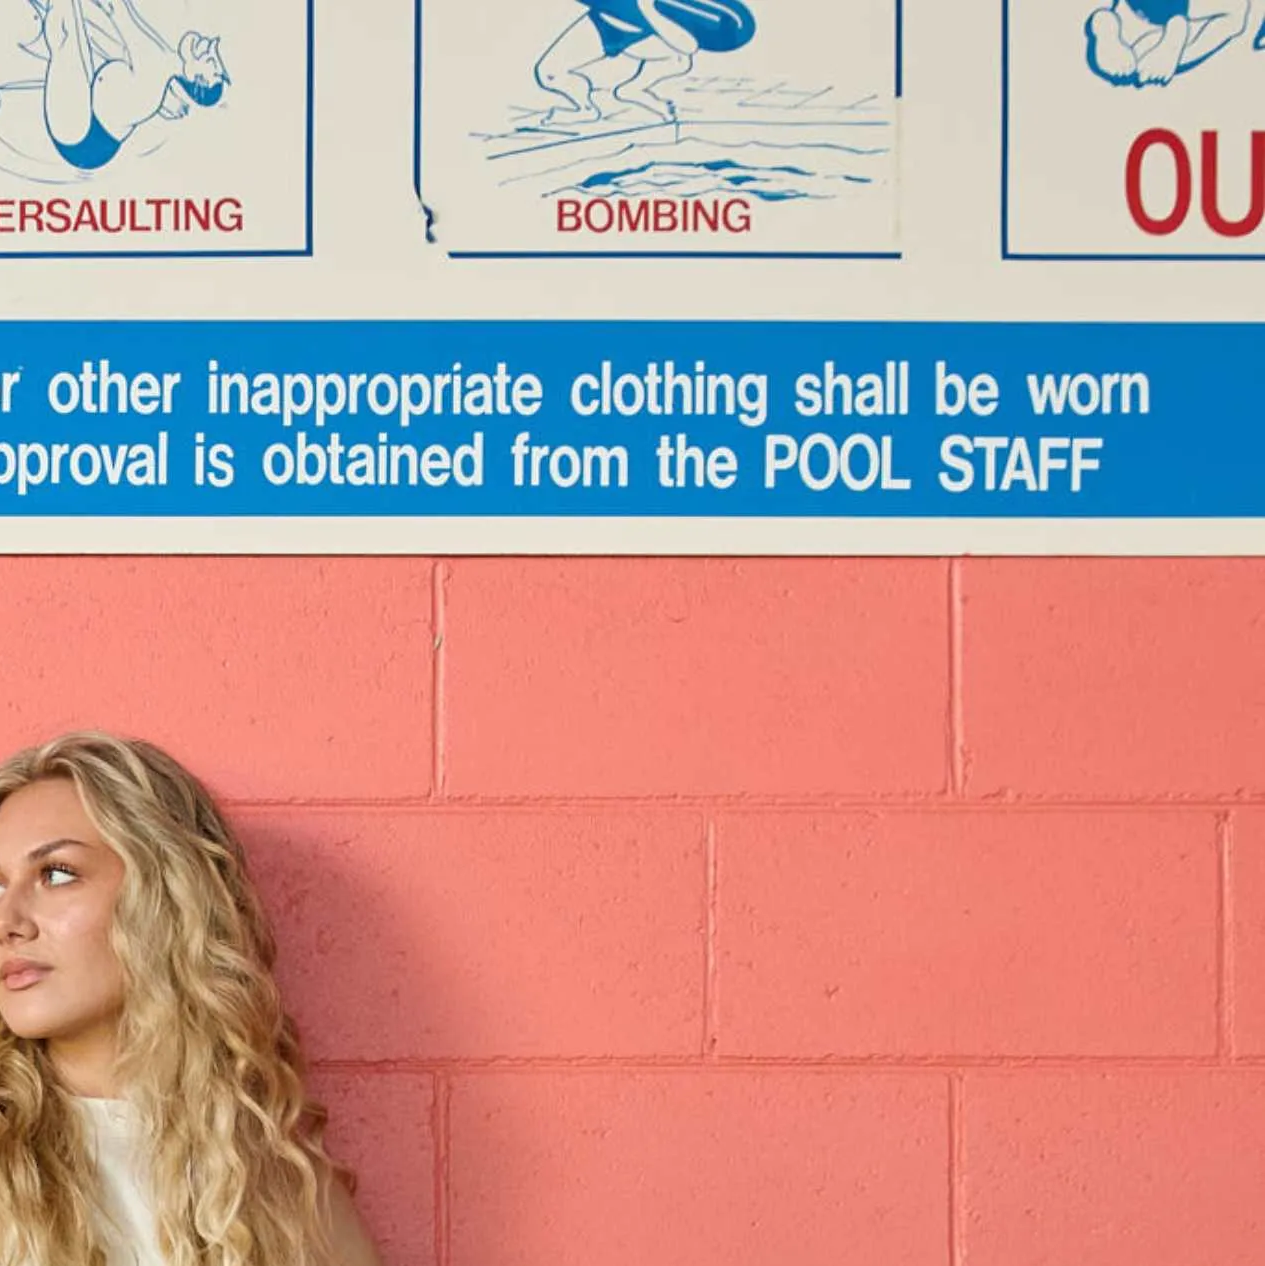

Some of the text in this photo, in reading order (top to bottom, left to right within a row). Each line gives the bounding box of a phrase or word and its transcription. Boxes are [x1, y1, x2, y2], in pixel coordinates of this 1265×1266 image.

[1125, 127, 1265, 238] OU
[556, 197, 752, 234] BOMBING
[48, 360, 181, 415] other
[208, 361, 543, 427] inappropriate
[571, 361, 768, 427] clothing
[795, 361, 909, 416] shall
[936, 362, 999, 416] be
[1027, 372, 1150, 416] worn
[195, 432, 234, 488] is
[263, 432, 484, 487] obtained
[511, 432, 628, 488] from
[656, 434, 738, 489] the
[765, 433, 911, 491] POOL
[939, 435, 1103, 492] STAFF
